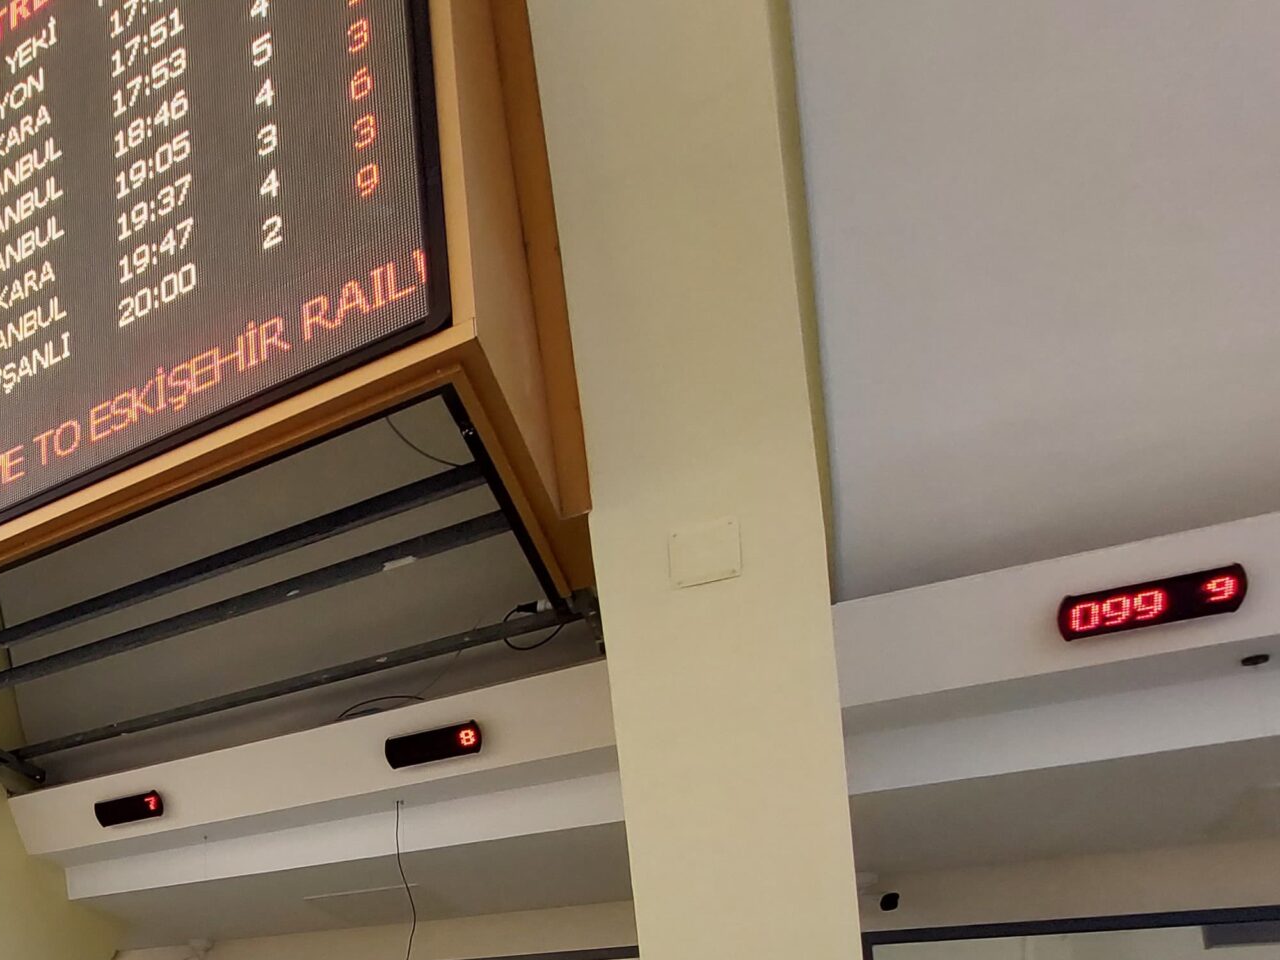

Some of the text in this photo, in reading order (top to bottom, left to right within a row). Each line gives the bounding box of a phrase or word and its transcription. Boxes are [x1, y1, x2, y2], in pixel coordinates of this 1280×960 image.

[111, 7, 184, 77] 17:51
[112, 47, 187, 118] 17:53
[114, 89, 189, 158] 18:46
[252, 32, 273, 67] 5
[116, 130, 191, 200] 19:05
[255, 78, 275, 107] 4
[347, 18, 369, 52] 3
[117, 173, 192, 242] 19:37
[257, 124, 278, 156] 3
[118, 217, 194, 284] 19:47
[259, 169, 280, 198] 4
[353, 113, 377, 150] 3
[118, 262, 197, 328] 20:00
[261, 215, 283, 250] 2
[357, 162, 379, 198] 9
[32, 419, 81, 465] TO
[1071, 576, 1235, 631] 099 9
[458, 727, 476, 747] 8
